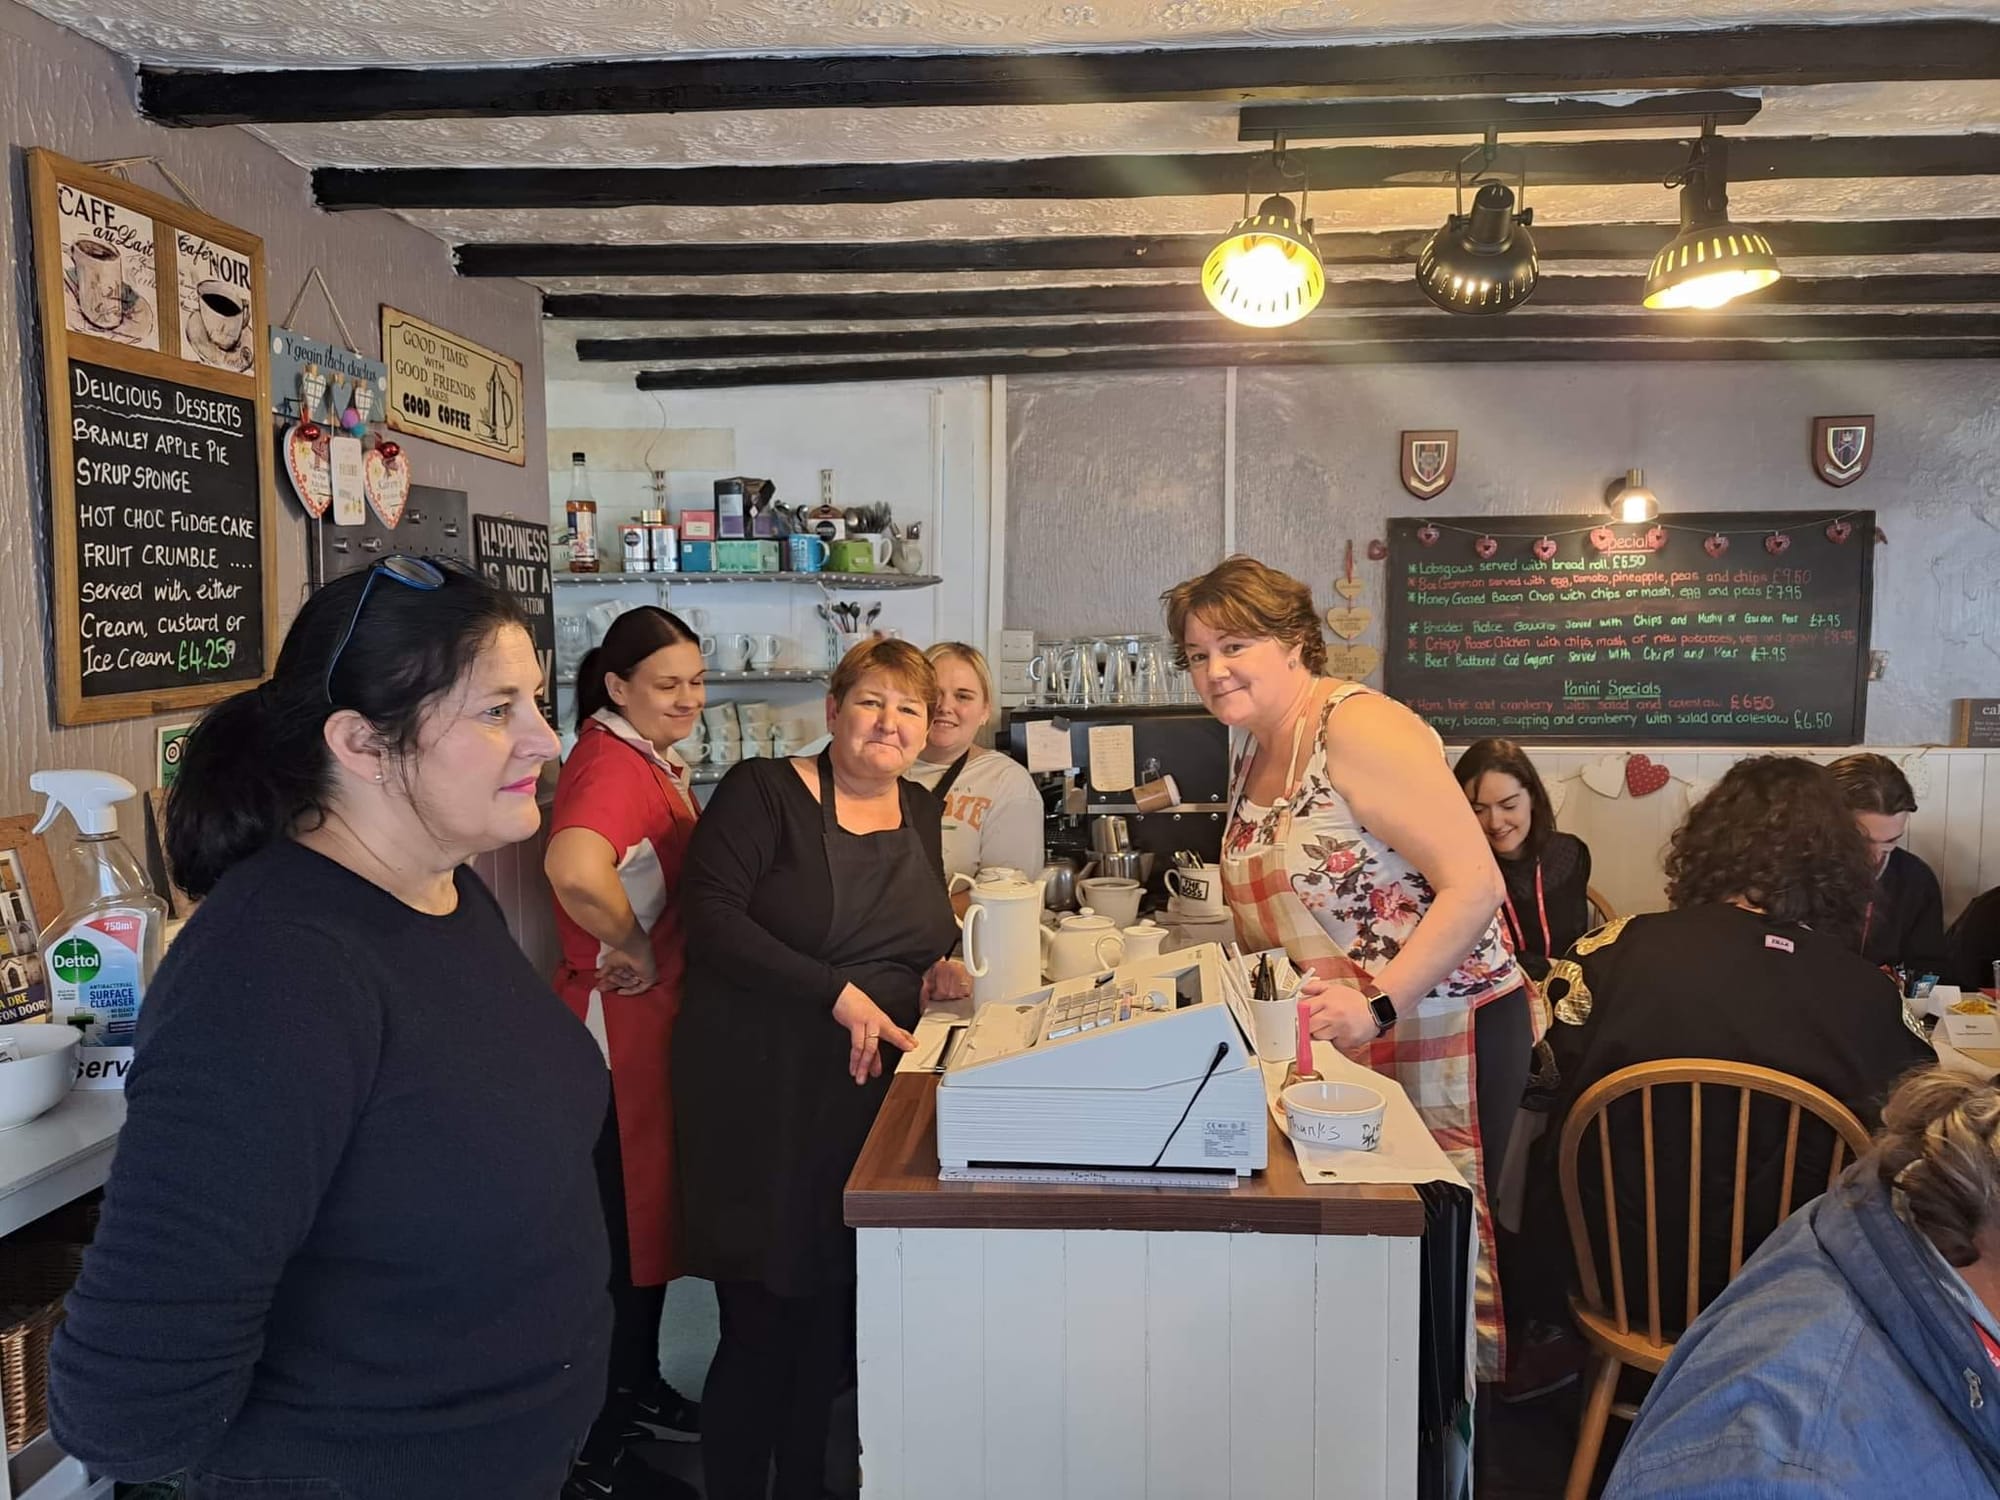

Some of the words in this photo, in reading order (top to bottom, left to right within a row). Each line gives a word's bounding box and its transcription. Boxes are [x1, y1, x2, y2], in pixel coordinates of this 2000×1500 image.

[58, 186, 117, 231] CAFE
[94, 225, 116, 244] au
[114, 223, 154, 258] Lait
[208, 250, 250, 290] NOIR
[286, 336, 294, 356] Y
[294, 345, 322, 367] gegin
[403, 330, 436, 355] GOOD
[440, 341, 470, 367] TIMES
[425, 356, 445, 372] WITH
[395, 359, 429, 383] GOOD
[433, 371, 477, 401] FRIENDS
[75, 368, 161, 410] DELICIOUS
[176, 391, 241, 428] DESSERTS
[425, 386, 450, 403] MAKES
[403, 393, 430, 418] GOOD
[438, 404, 471, 432] COFFEE
[73, 418, 149, 450] BRAMLEY
[155, 434, 201, 460] APPLE
[206, 440, 229, 465] PIE
[77, 458, 131, 485] SYRUP
[136, 465, 192, 493] SPONGE
[80, 504, 116, 528] HOT
[124, 507, 165, 528] CHOC
[171, 511, 218, 534] FUDGE
[221, 517, 255, 539] CAKE
[480, 520, 549, 563] HAPPINESS
[1607, 532, 1649, 557] pecial
[84, 543, 133, 568] FRUIT
[142, 545, 219, 569] CRUMBLE
[1480, 558, 1517, 571] served
[1522, 559, 1547, 571] with
[1552, 557, 1584, 571] bread
[81, 581, 143, 602] Served
[155, 578, 191, 601] with
[197, 578, 242, 601] either
[506, 564, 535, 594] NOT
[542, 568, 550, 594] A
[1438, 577, 1485, 591] Gammon
[1489, 578, 1522, 588] served
[1524, 576, 1546, 588] with
[1612, 571, 1668, 588] pineapple,
[1671, 571, 1699, 587] peas
[1706, 571, 1729, 583] and
[1734, 571, 1768, 586] chips
[1418, 591, 1451, 607] Honey
[1492, 591, 1524, 603] Bacon
[1529, 590, 1555, 604] Chop
[1560, 589, 1586, 602] with
[1591, 588, 1620, 601] chips
[1626, 588, 1638, 599] or
[1641, 587, 1675, 599] mash,
[1680, 588, 1701, 600] egg
[1708, 586, 1728, 597] and
[1735, 587, 1762, 600] peas
[81, 612, 147, 639] Cream,
[158, 613, 219, 634] custard
[226, 615, 246, 632] or
[1600, 617, 1623, 628] with
[1634, 614, 1663, 628] Chips
[1671, 615, 1687, 626] and
[1425, 636, 1461, 654] Crispy
[1494, 635, 1530, 650] Chicken
[1537, 636, 1560, 648] with
[1632, 634, 1646, 645] or
[1766, 633, 1782, 645] and
[83, 645, 113, 676] Ice
[118, 647, 175, 671] Cream
[1425, 654, 1449, 668] Beer
[1456, 654, 1496, 668] Battered
[1504, 653, 1520, 666] Cod
[1568, 651, 1597, 664] Served
[1643, 647, 1674, 662] Chips
[1684, 647, 1704, 659] and
[1564, 680, 1600, 696] Panini
[1608, 680, 1662, 698] Specials
[1474, 697, 1496, 711] and
[1500, 698, 1554, 713] cranberry
[1598, 699, 1629, 711] salad
[1636, 698, 1662, 710] and
[1464, 714, 1499, 728] bacon,
[1554, 714, 1574, 726] and
[1578, 712, 1638, 726] cranberry
[1646, 712, 1673, 724] with
[1680, 712, 1708, 724] salad
[1712, 712, 1734, 724] and
[1736, 712, 1789, 725] coleslaw
[104, 921, 133, 932] 750ml
[54, 953, 99, 968] Dettol
[90, 988, 134, 1000] SURFACE
[90, 998, 135, 1008] CLEANSER
